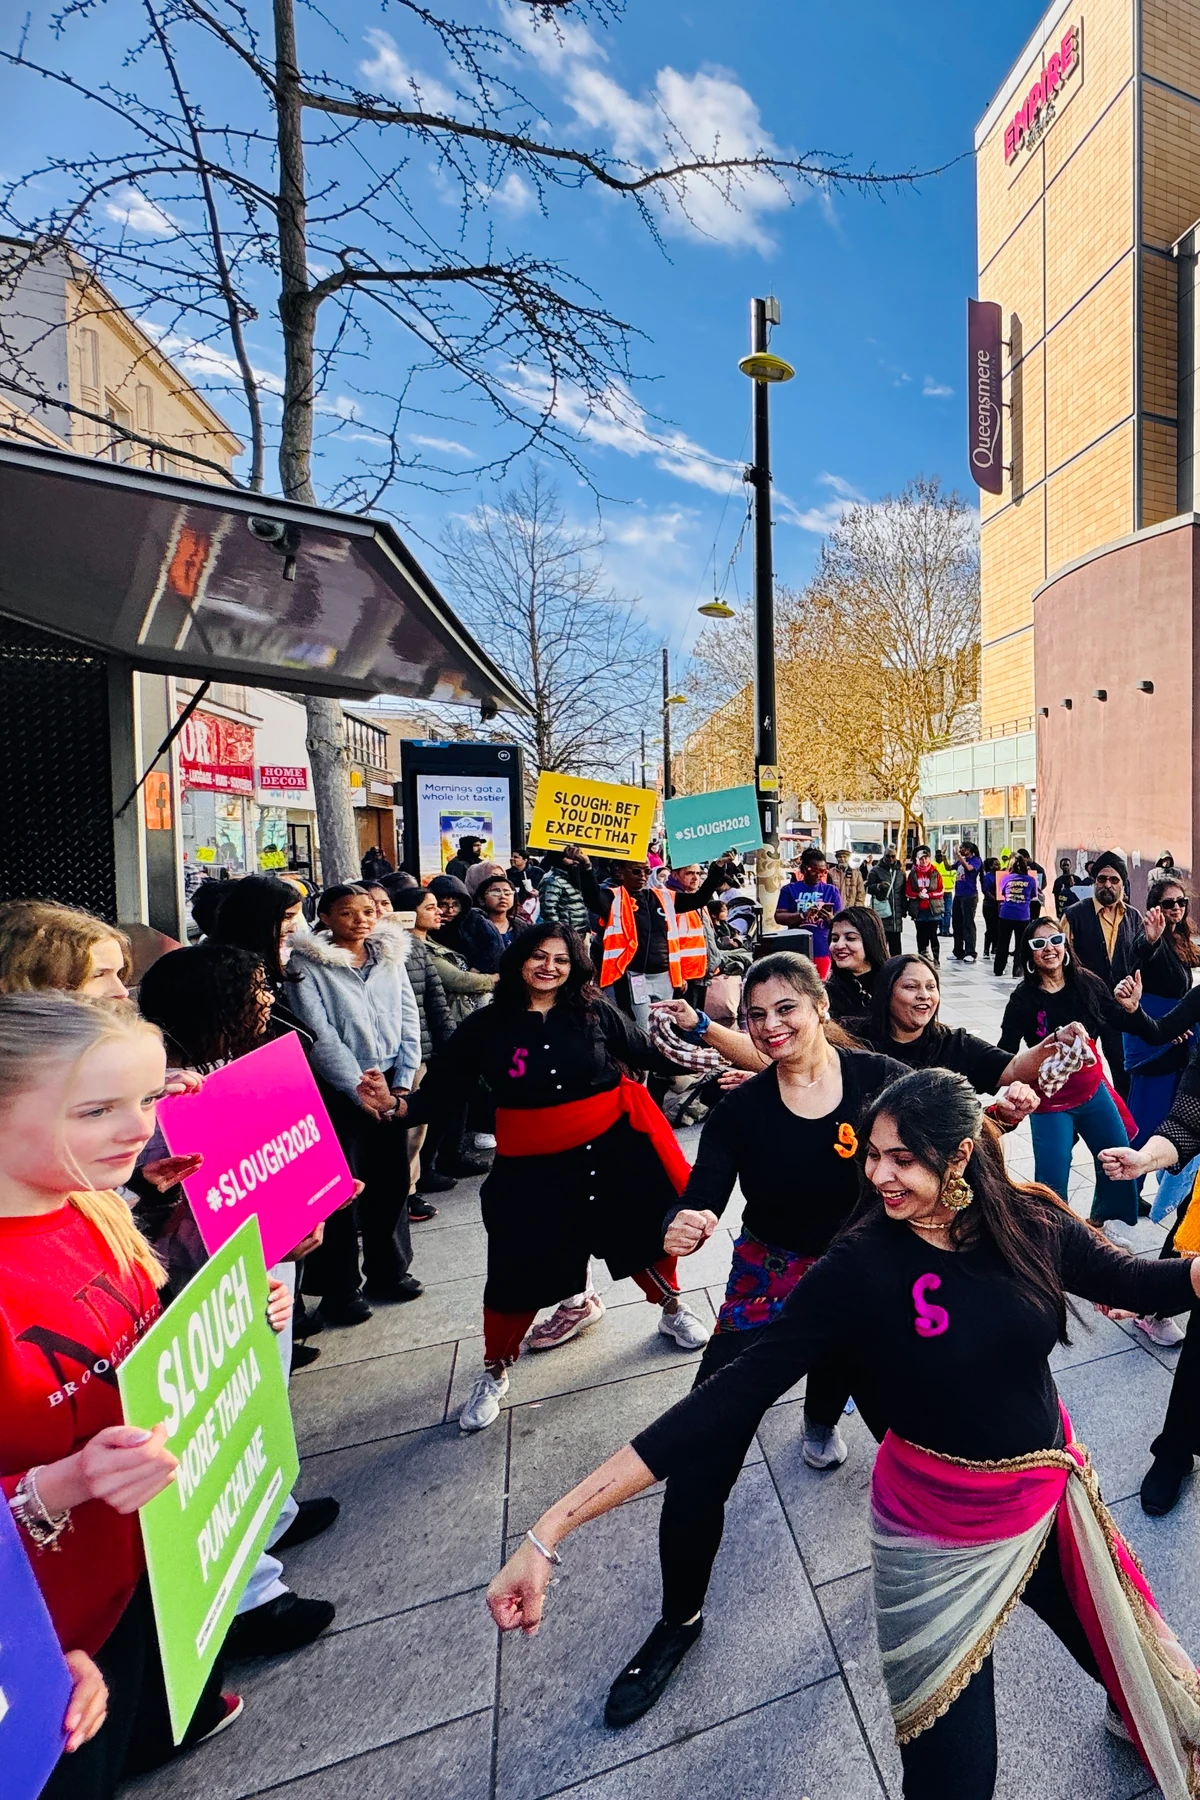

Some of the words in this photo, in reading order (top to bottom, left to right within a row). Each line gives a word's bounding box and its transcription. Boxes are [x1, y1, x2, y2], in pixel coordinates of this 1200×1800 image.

[1004, 24, 1079, 165] EMPIRE
[972, 350, 1000, 468] Queensmere
[262, 776, 306, 786] DECOR
[264, 767, 303, 777] HOME
[422, 793, 454, 801] whole
[473, 794, 506, 802] tastier
[425, 784, 473, 793] Mornings
[475, 785, 493, 793] got
[553, 791, 613, 812] SLOUGH:
[615, 801, 640, 816] BET
[560, 807, 589, 823] YOU
[591, 812, 631, 830] DIDNT
[674, 815, 750, 840] #SLOUGH2028
[546, 820, 605, 839] EXPECT
[606, 829, 638, 845] THAT
[798, 891, 824, 902] LOVE
[206, 1113, 321, 1213] #SLOUGH2028
[157, 1255, 254, 1438] SLOUGH
[175, 1407, 220, 1512] MORE
[215, 1358, 252, 1439] THAN
[250, 1346, 262, 1391] A
[197, 1425, 267, 1584] PUNCHLINE
